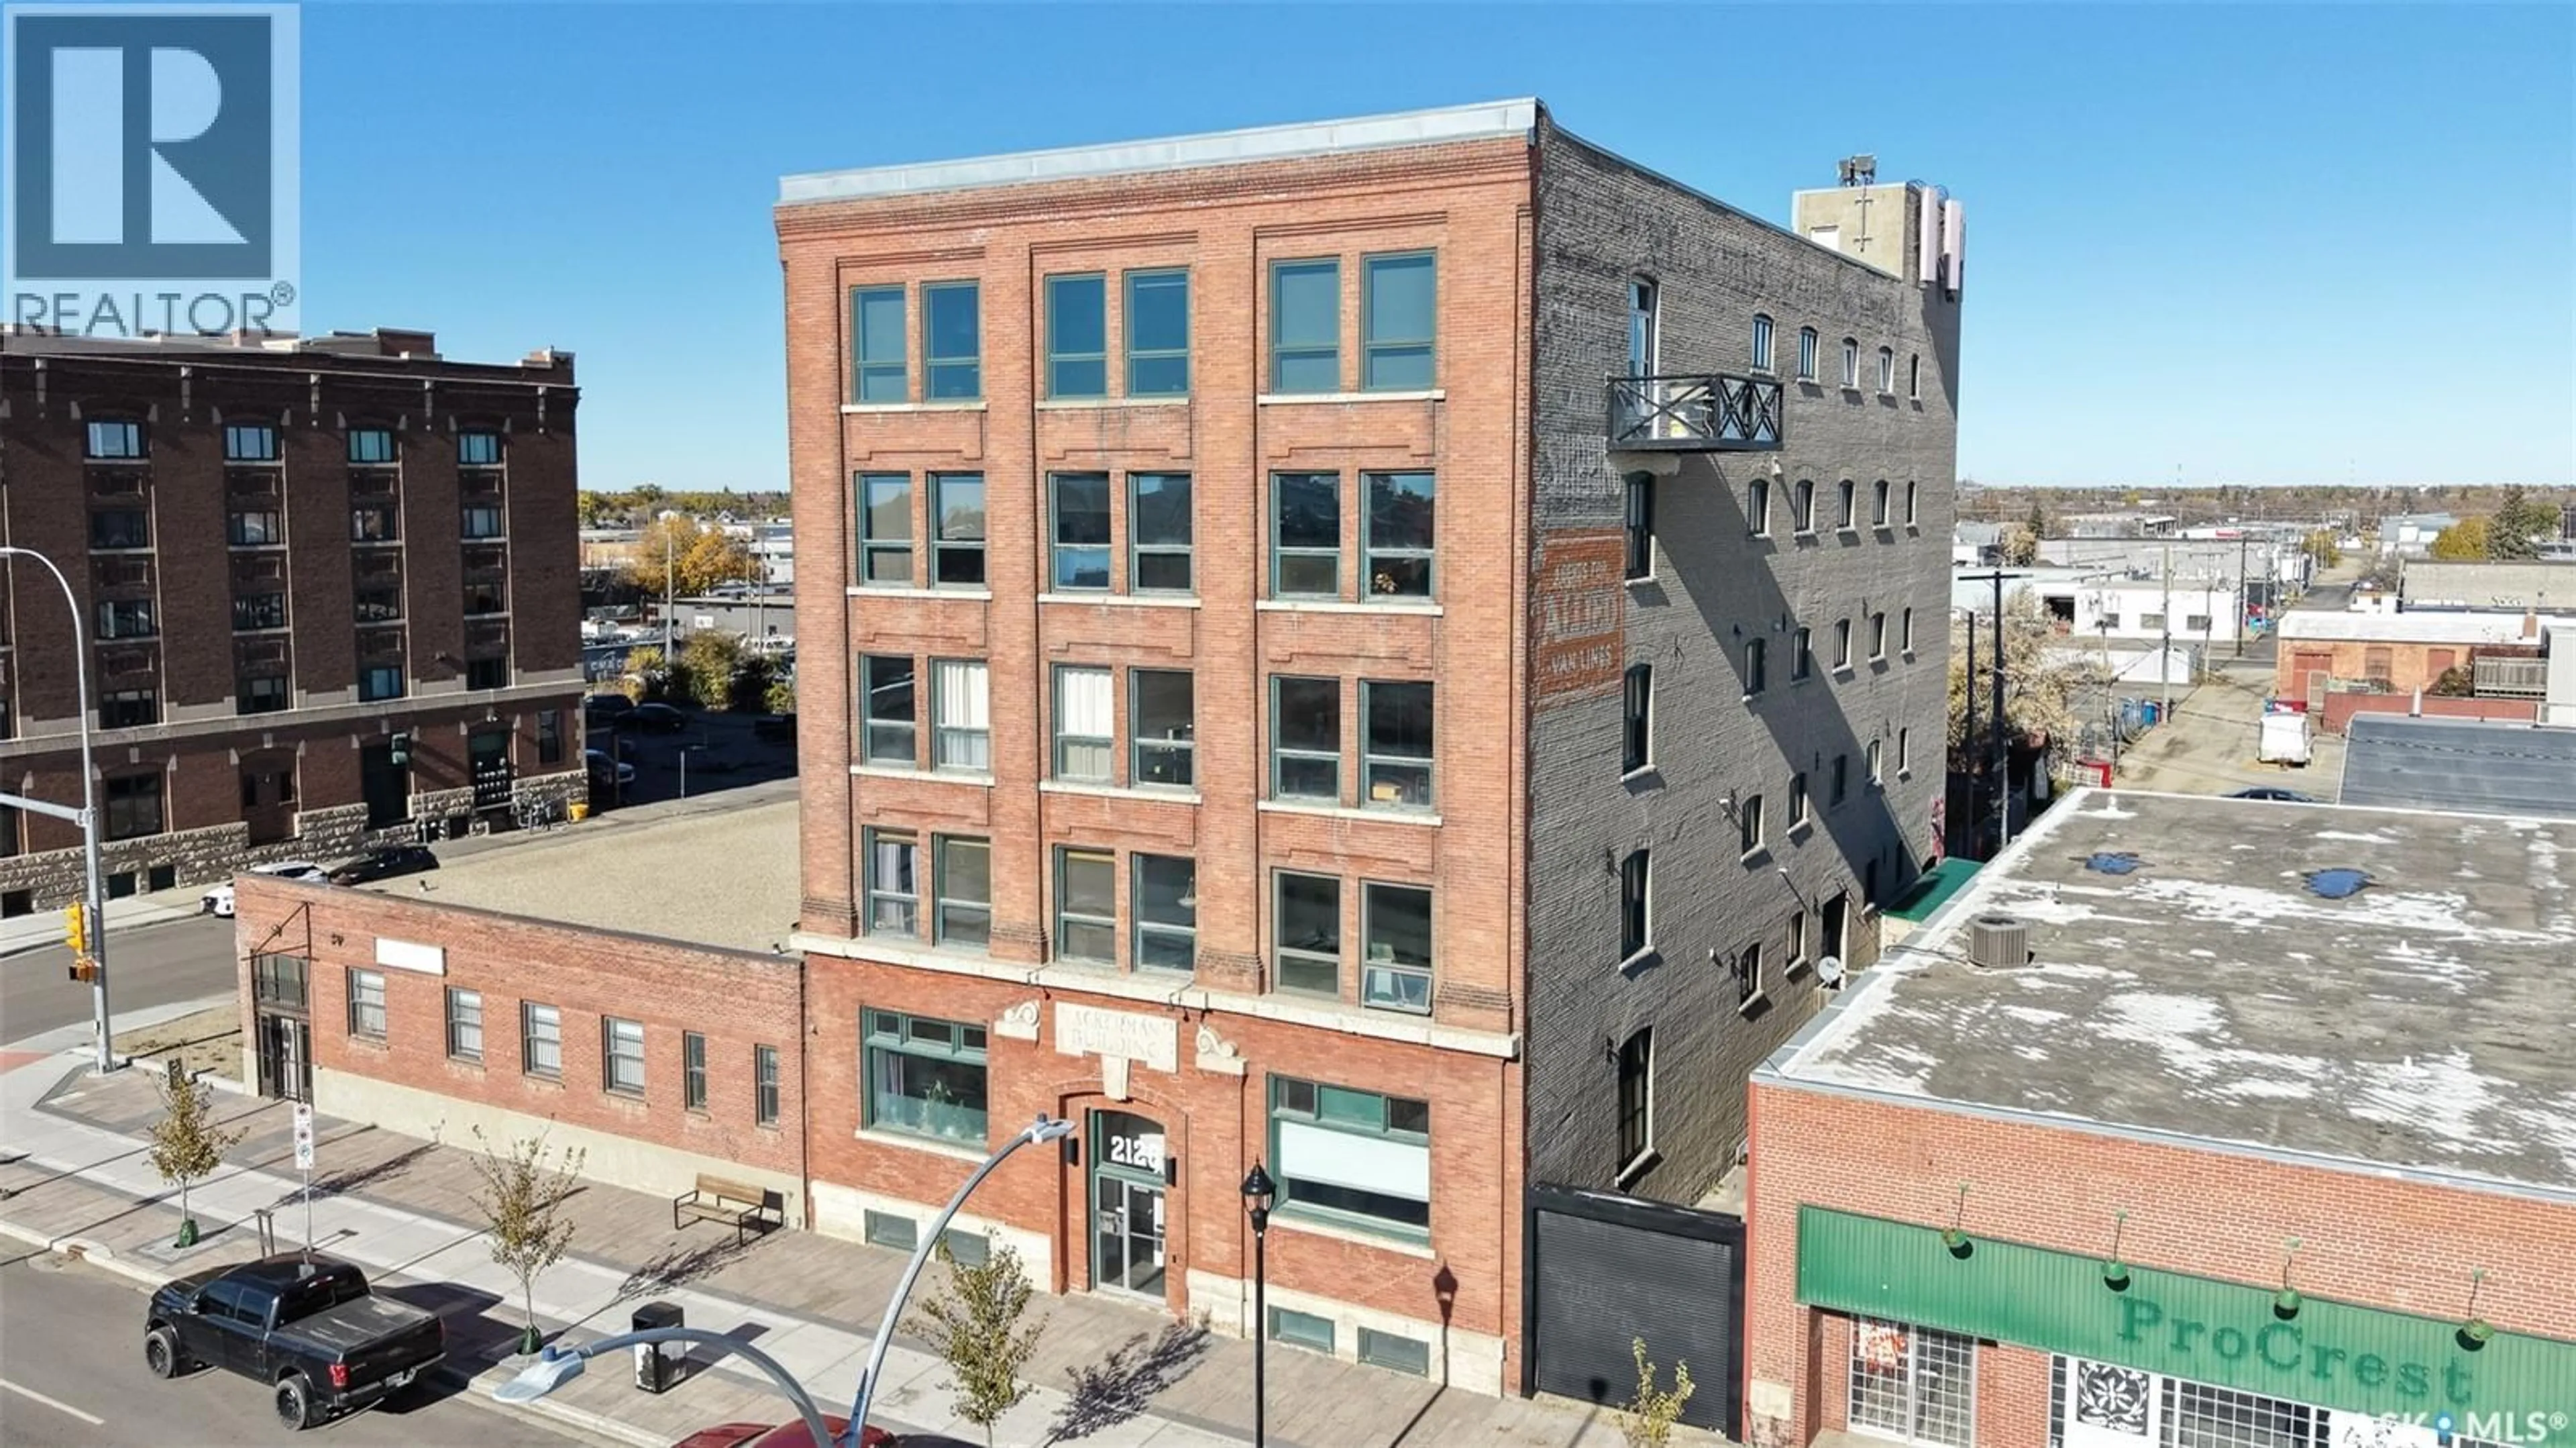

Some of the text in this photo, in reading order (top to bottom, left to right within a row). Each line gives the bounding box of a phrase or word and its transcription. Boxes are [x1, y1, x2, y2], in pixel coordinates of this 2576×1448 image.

[1551, 643, 1612, 675] VAN LINES
[2116, 1294, 2474, 1406] ProCrest
